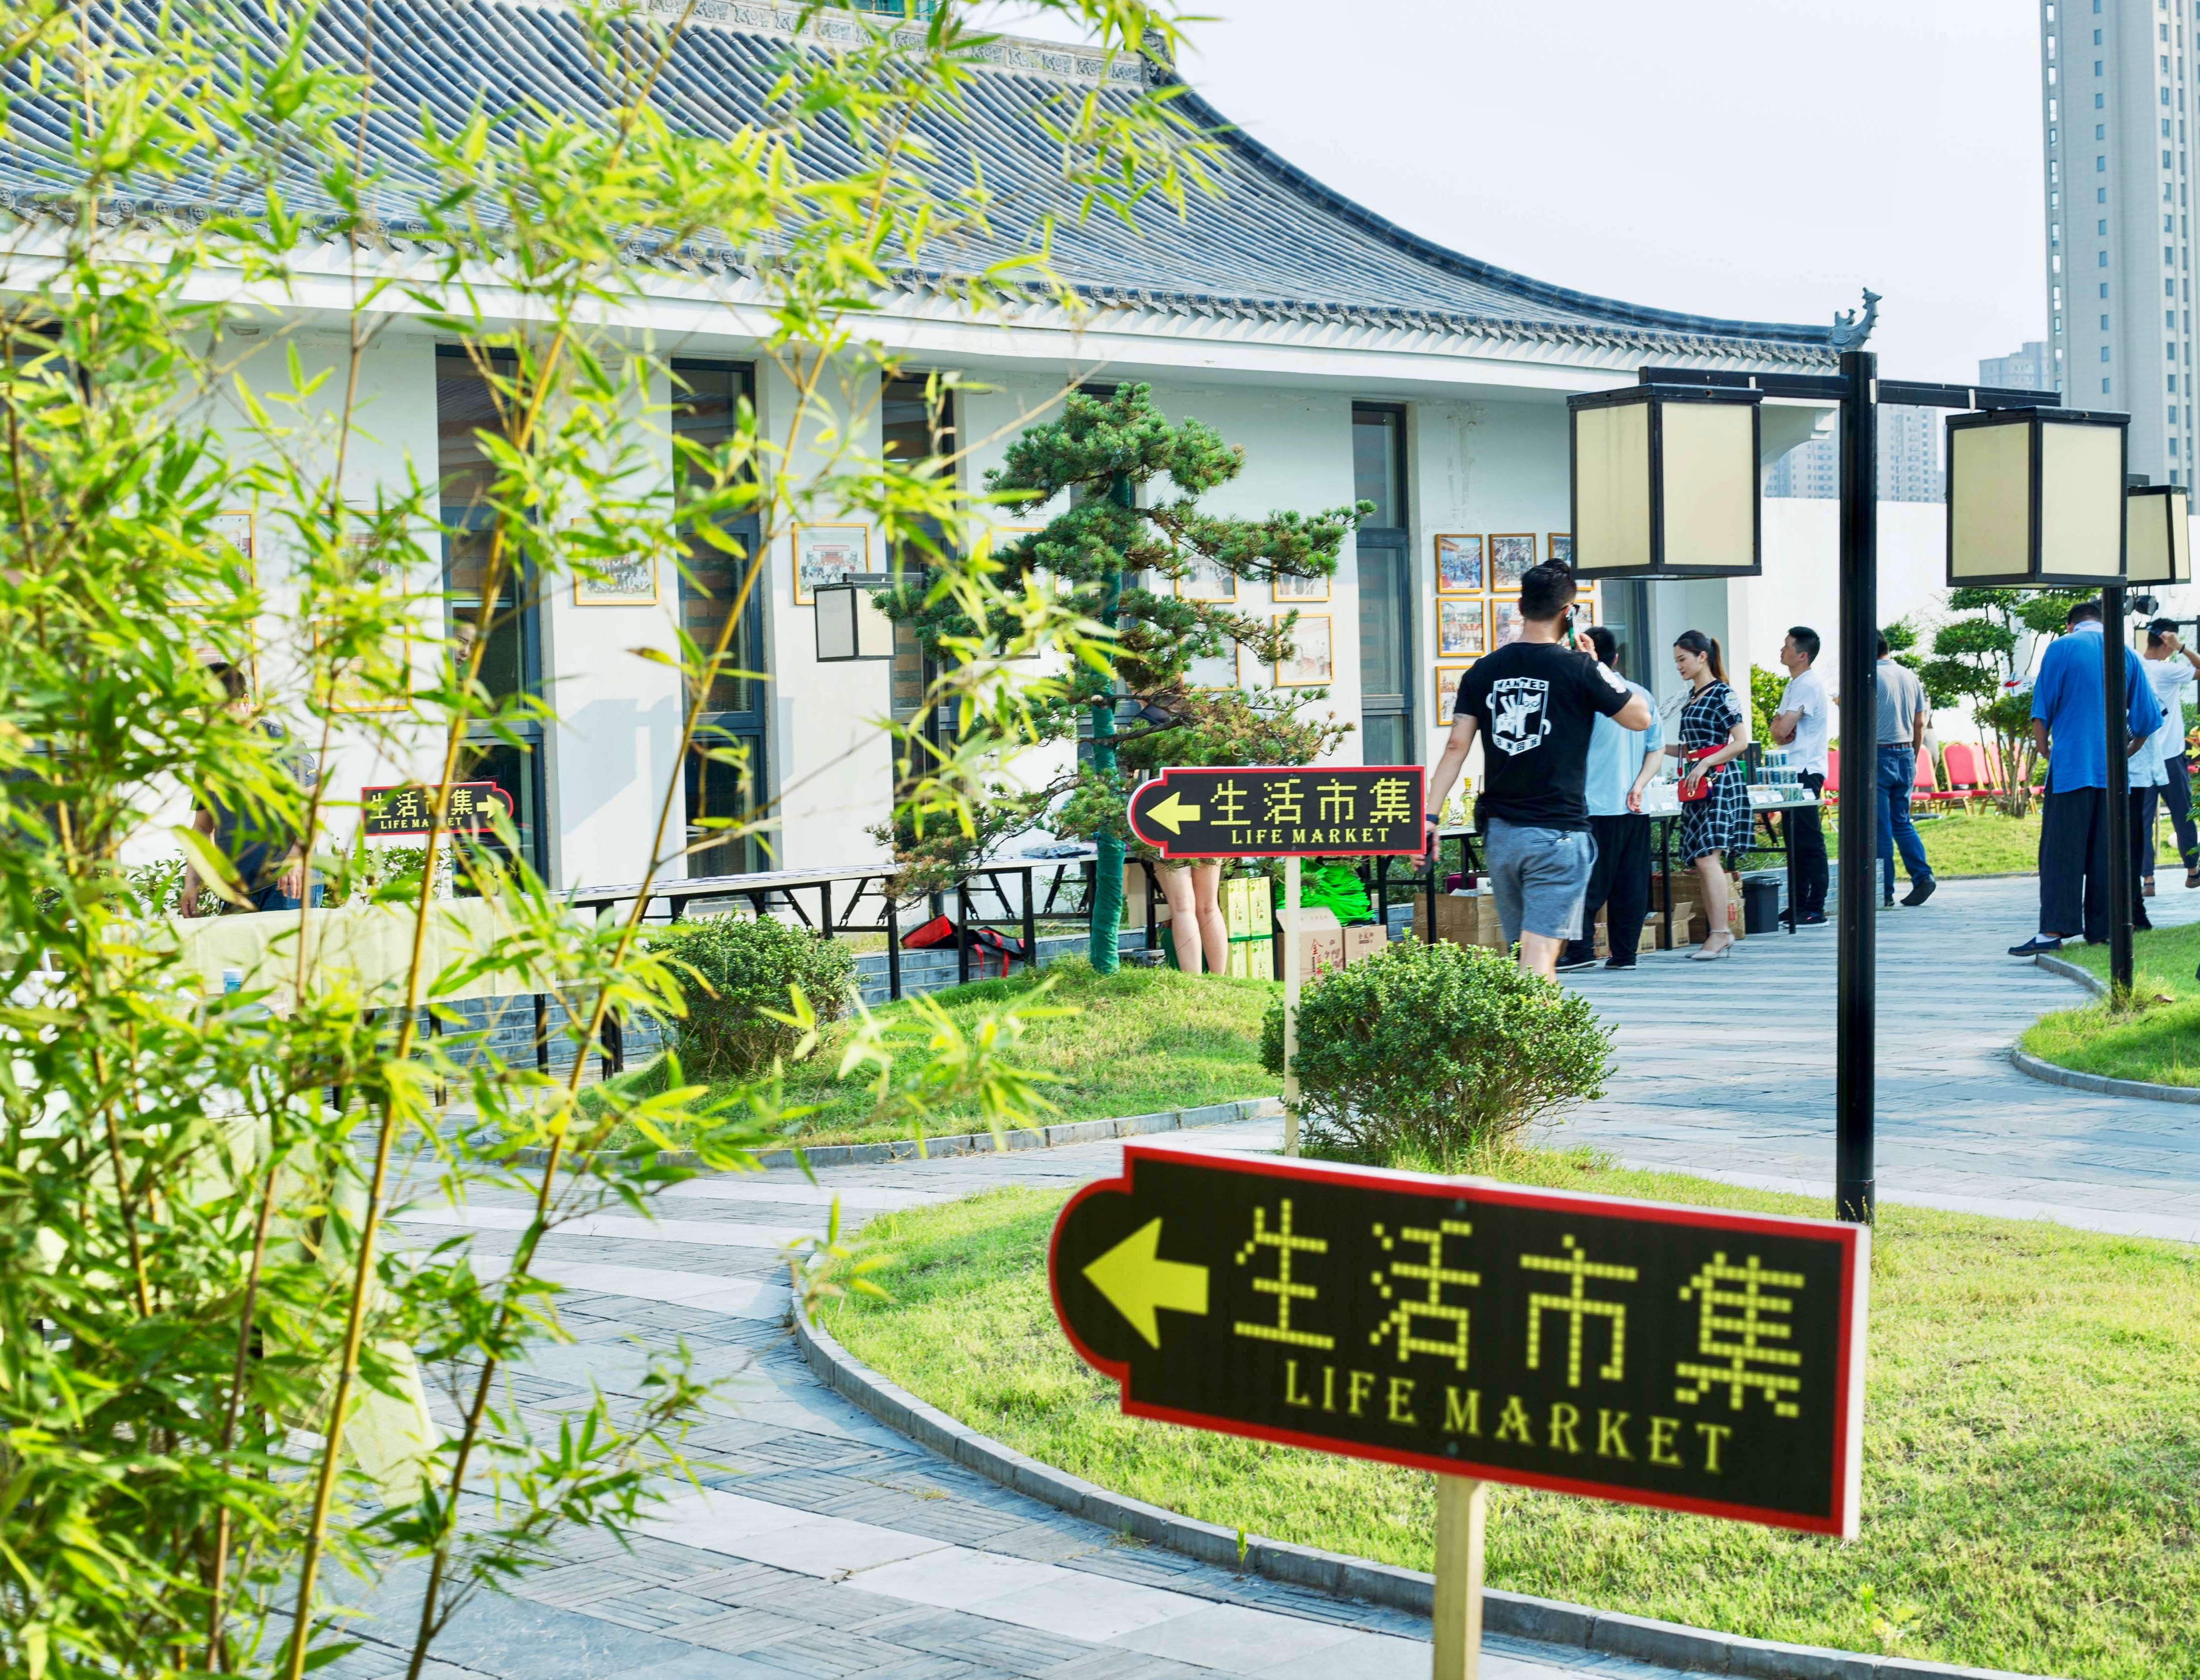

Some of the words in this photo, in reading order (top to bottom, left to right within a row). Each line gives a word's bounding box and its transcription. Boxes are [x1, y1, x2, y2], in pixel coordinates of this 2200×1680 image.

[1497, 678, 1546, 689] WANTED
[369, 789, 473, 819] 生活集
[1210, 777, 1411, 825] 生活市集
[380, 819, 408, 829] LIFE
[412, 817, 463, 828] MAET
[1231, 829, 1283, 844] LIFE
[1292, 828, 1390, 843] MARKET
[1233, 1198, 1806, 1418] 生活市集
[1284, 1358, 1417, 1426] LIFE
[1443, 1385, 1733, 1474] MARKET
